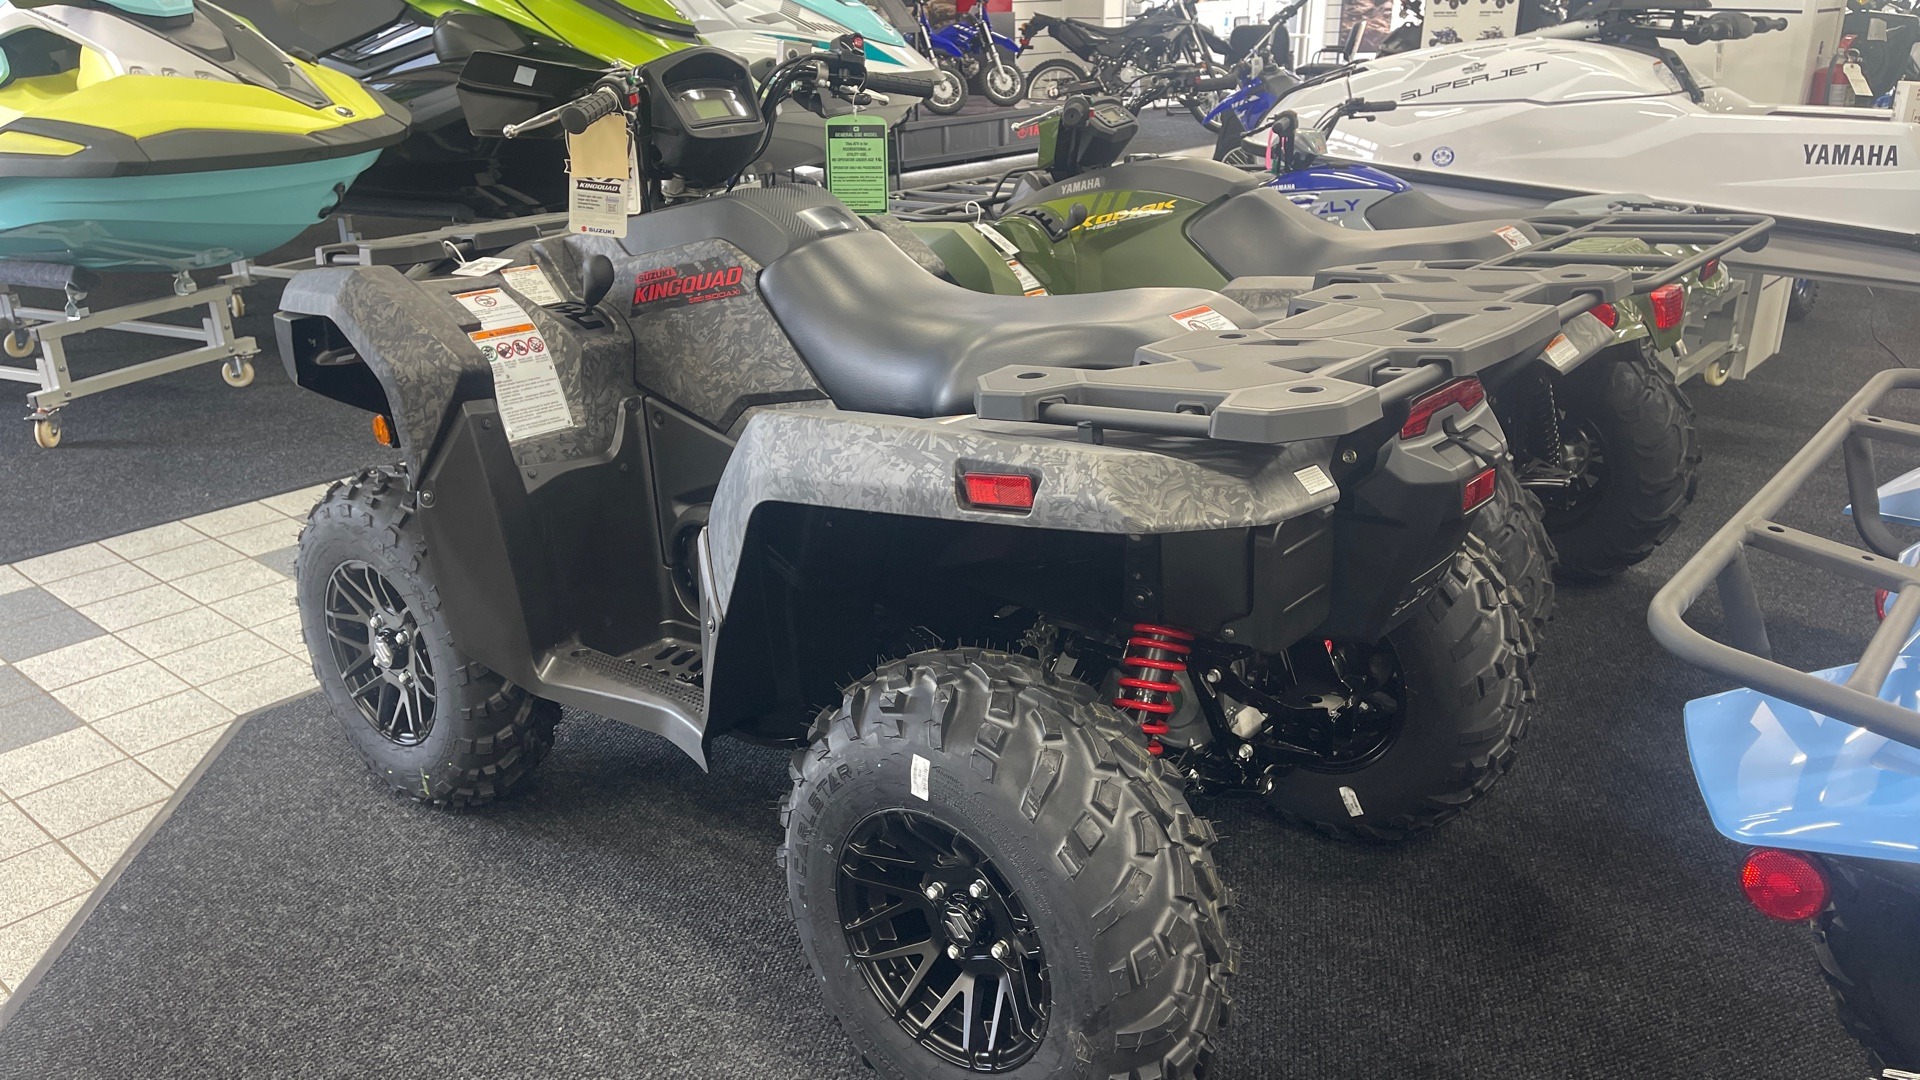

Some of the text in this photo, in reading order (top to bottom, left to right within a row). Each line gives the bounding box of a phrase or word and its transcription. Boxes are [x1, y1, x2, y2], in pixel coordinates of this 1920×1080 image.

[1400, 61, 1548, 101] SUPERJET
[1803, 144, 1898, 166] YAMAHA
[579, 181, 618, 192] KINGQUAD
[1061, 178, 1101, 195] YAMAHA
[588, 227, 615, 235] SUZUKI
[638, 268, 672, 283] SUZUKI
[633, 266, 743, 305] KINGQUAD
